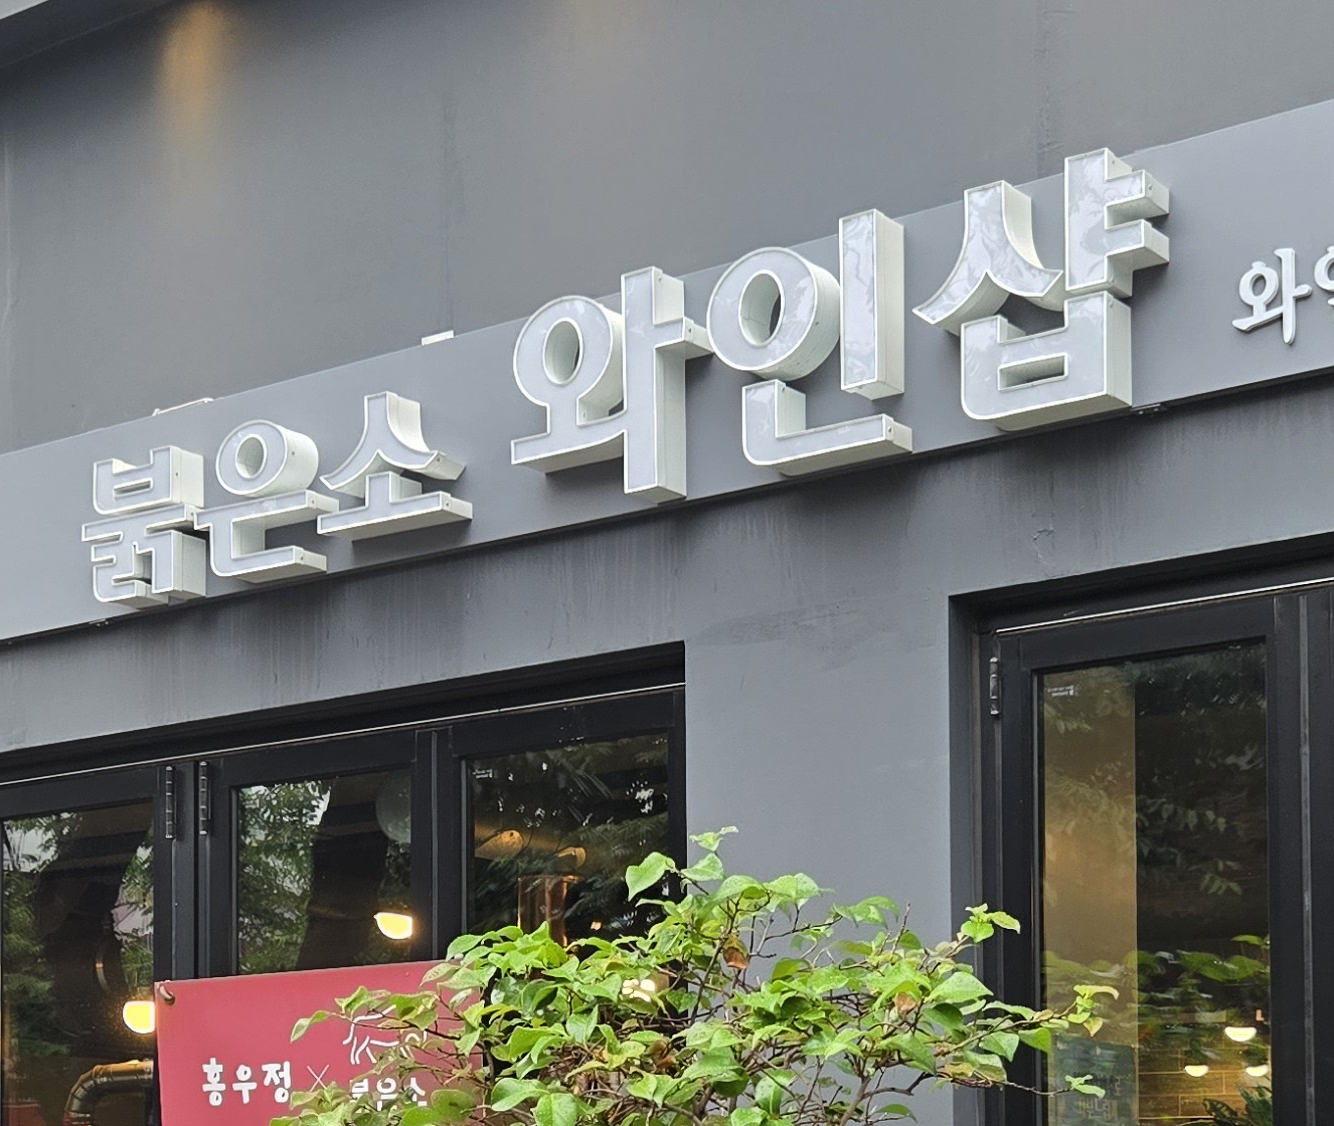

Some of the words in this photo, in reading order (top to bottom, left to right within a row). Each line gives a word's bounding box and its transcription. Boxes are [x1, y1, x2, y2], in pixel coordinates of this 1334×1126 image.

[79, 389, 473, 607] 붉은소
[509, 146, 1172, 504] 와인샵
[201, 1057, 292, 1107] 홍우정
